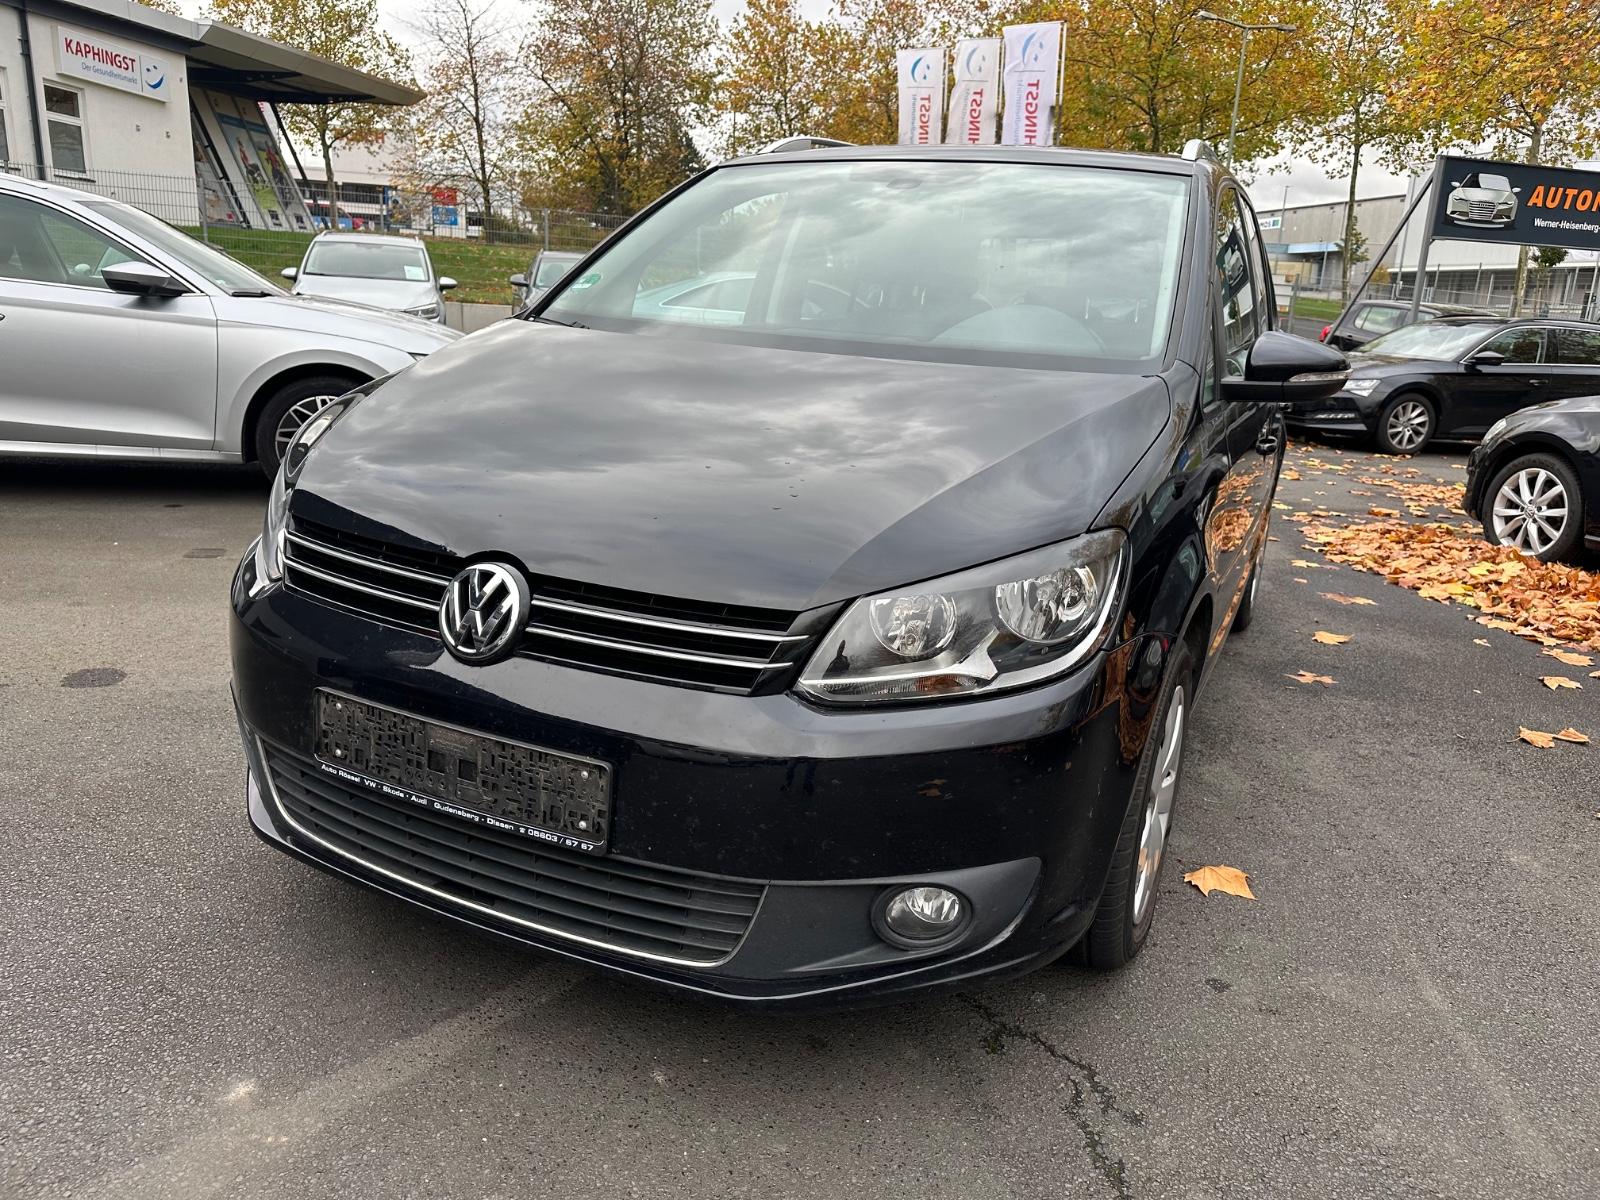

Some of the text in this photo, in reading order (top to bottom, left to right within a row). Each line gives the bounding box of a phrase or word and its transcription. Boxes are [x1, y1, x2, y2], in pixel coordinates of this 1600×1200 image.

[64, 37, 135, 72] KAPHINGST
[321, 763, 337, 775] Auto
[364, 779, 377, 788] VW
[410, 795, 428, 806] Audi
[433, 802, 480, 822] Gudensberg
[486, 817, 514, 831] Dissen
